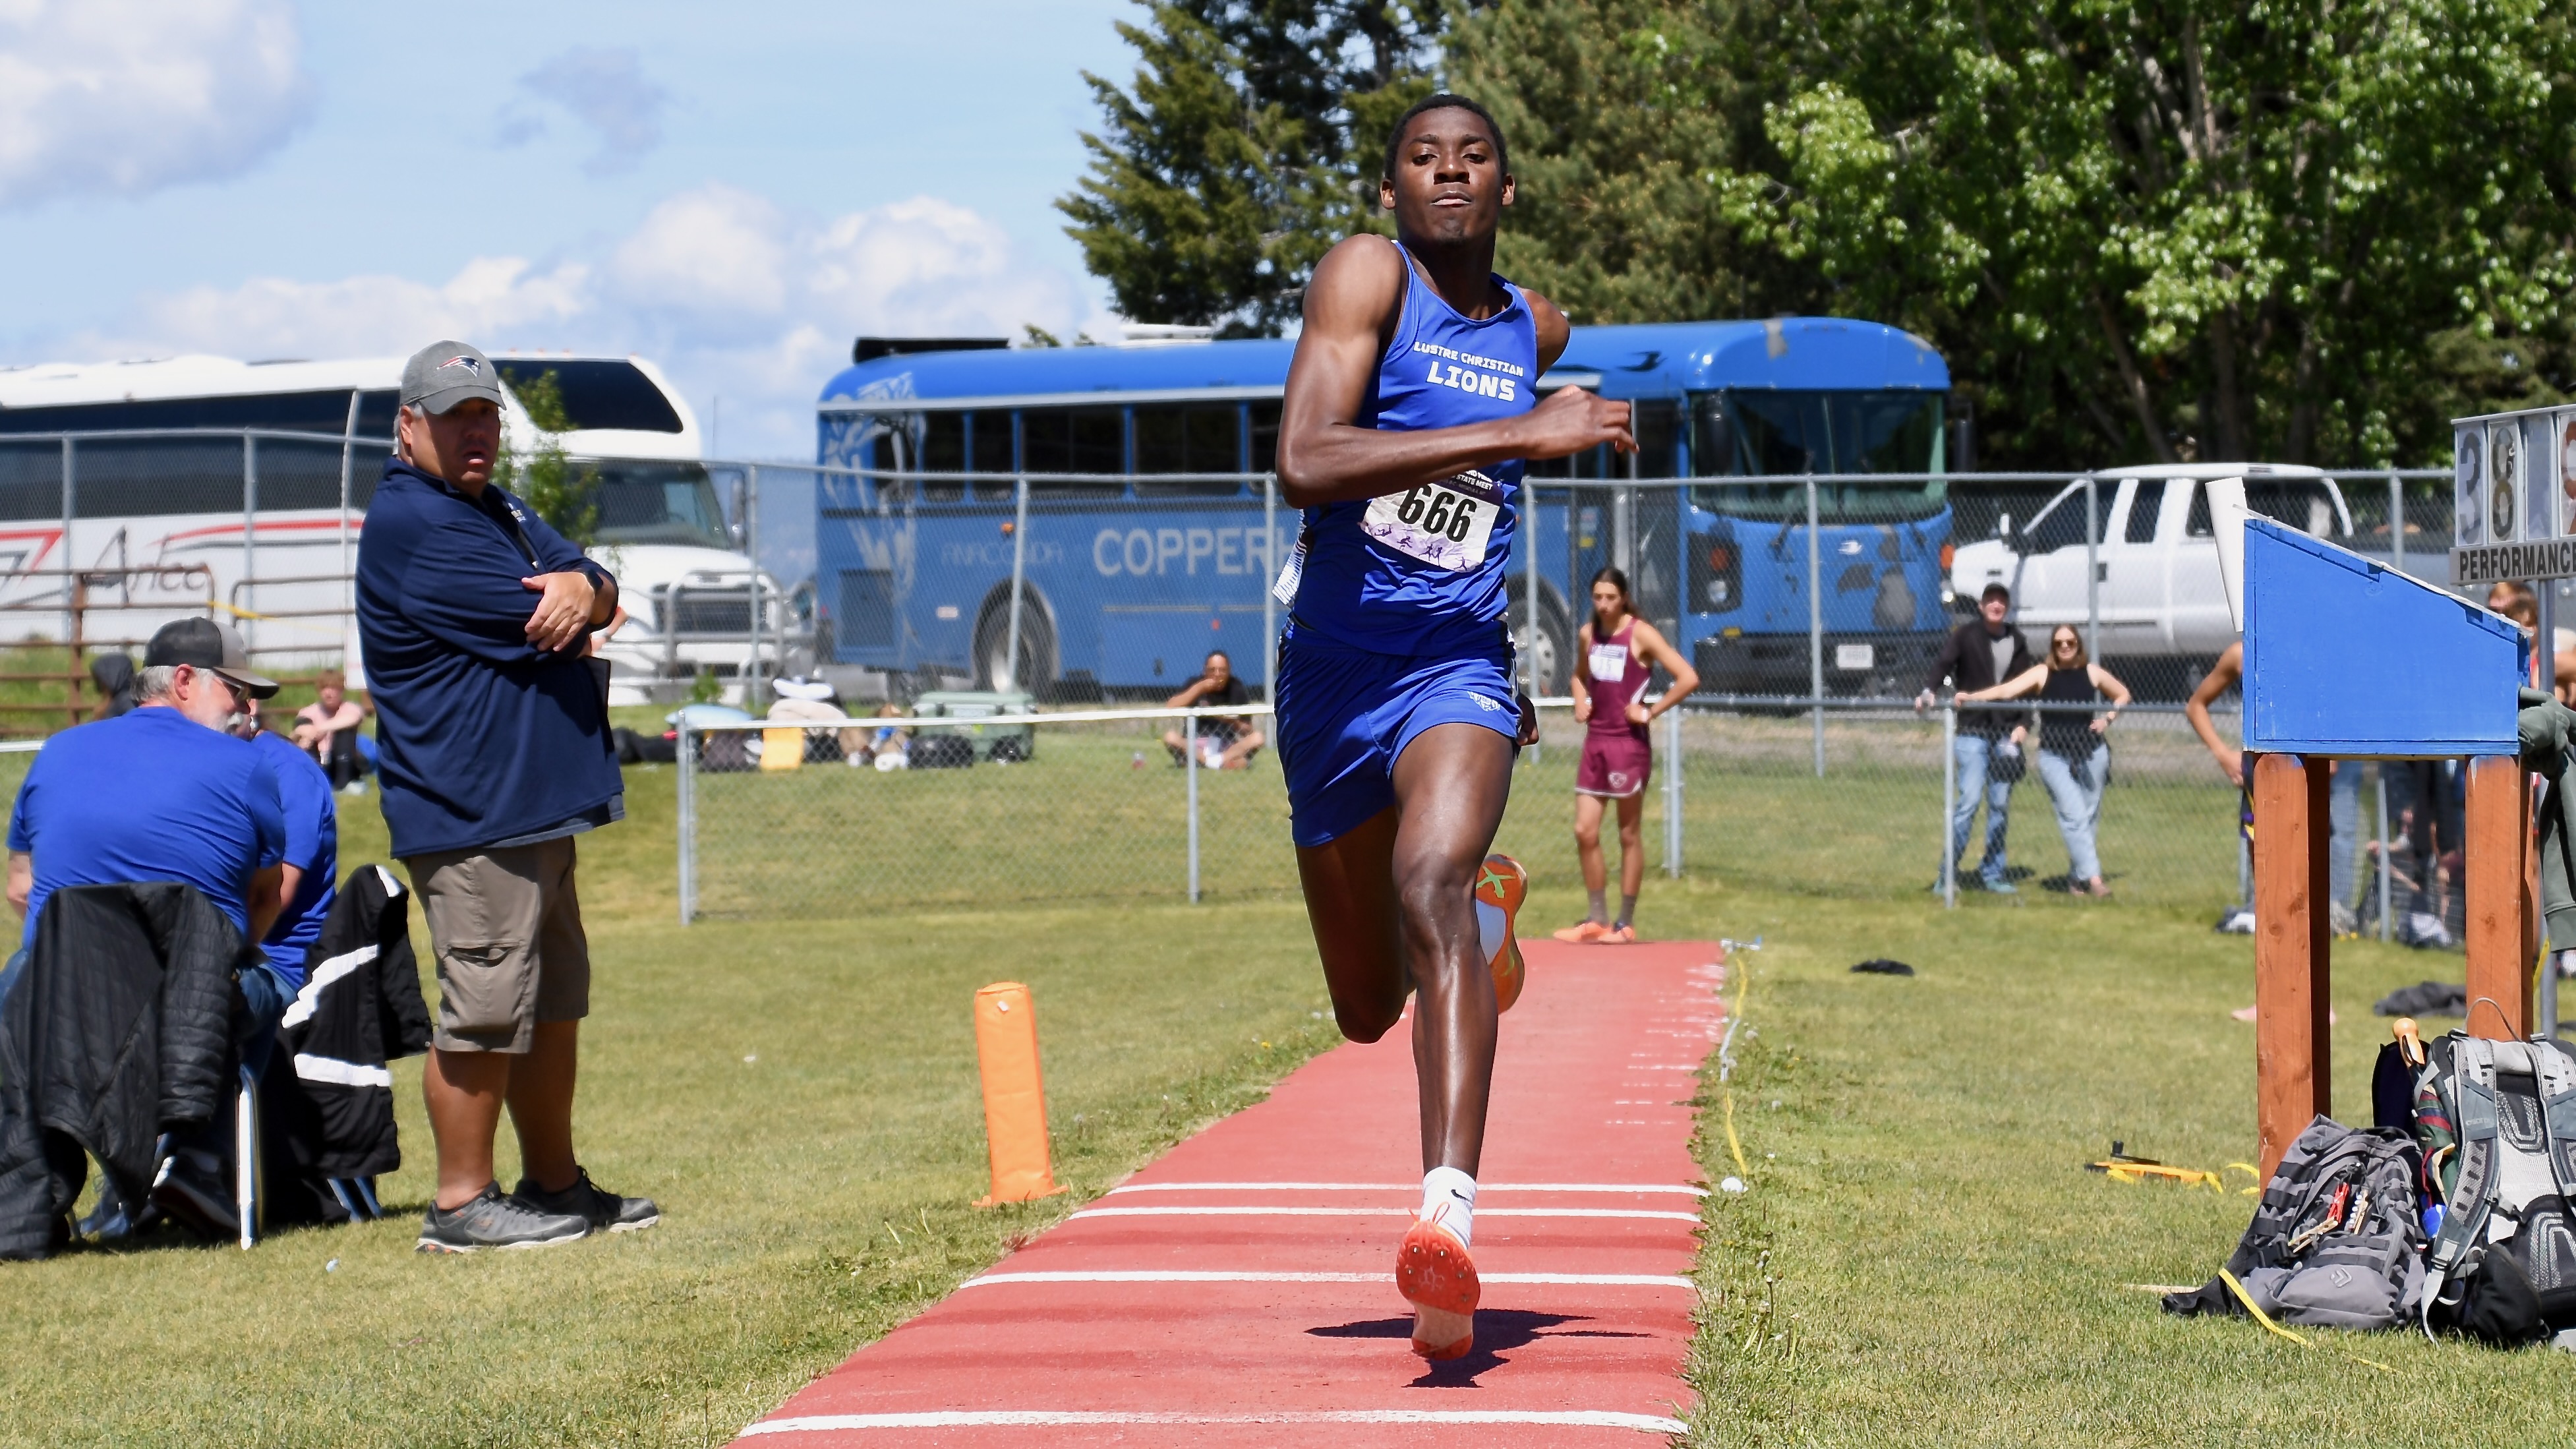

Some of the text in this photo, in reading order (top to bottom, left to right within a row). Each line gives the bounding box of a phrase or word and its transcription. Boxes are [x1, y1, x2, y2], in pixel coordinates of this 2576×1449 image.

[1413, 341, 1523, 377] LUSTRE CHRISTIAN
[1426, 361, 1515, 402] LIONS
[1455, 474, 1477, 485] STATE
[1476, 480, 1493, 490] MEET
[1397, 484, 1477, 543] 666
